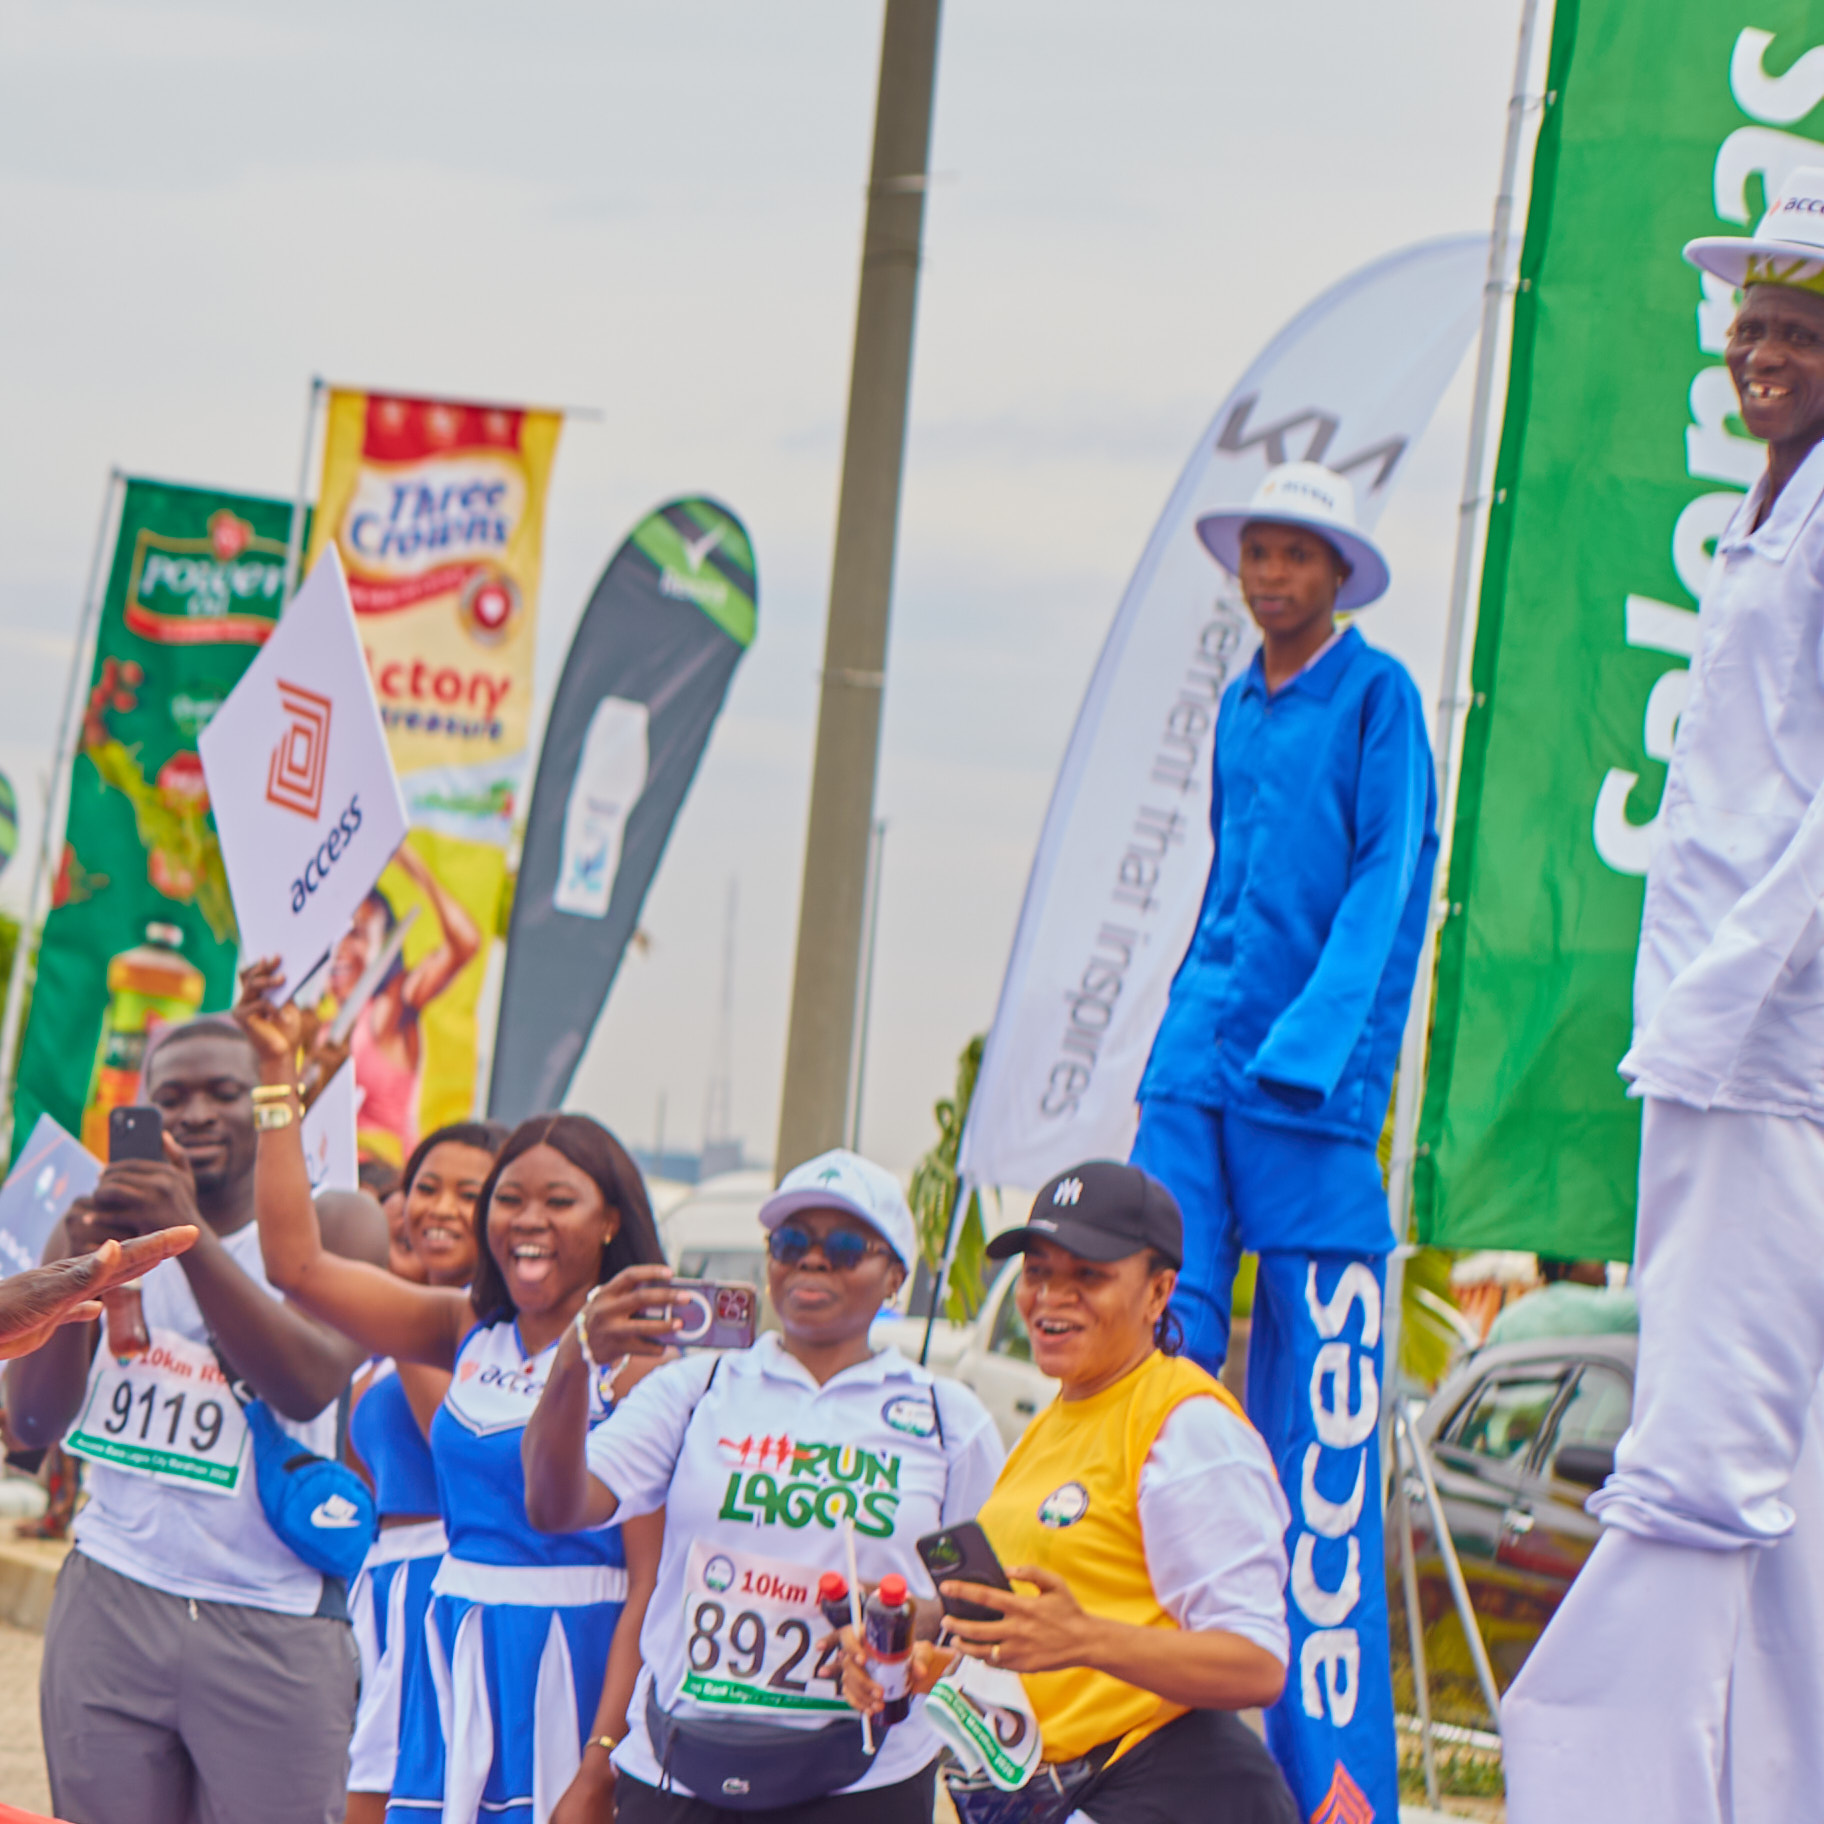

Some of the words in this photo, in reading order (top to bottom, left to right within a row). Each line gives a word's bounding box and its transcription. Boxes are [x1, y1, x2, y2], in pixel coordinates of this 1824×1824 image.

[386, 479, 508, 524] Three
[349, 510, 511, 559] Crowns
[141, 553, 286, 600] Power
[1151, 575, 1246, 793] vement
[290, 793, 364, 917] access
[1114, 802, 1189, 914] that
[1040, 922, 1151, 1122] inspires
[139, 1346, 193, 1379] 10km
[480, 1358, 544, 1398] acce
[103, 1381, 226, 1453] 9119
[790, 1442, 900, 1491] RUN
[718, 1468, 899, 1539] LAGOS
[740, 1568, 808, 1606] 10km
[959, 1715, 1003, 1758] Marathon
